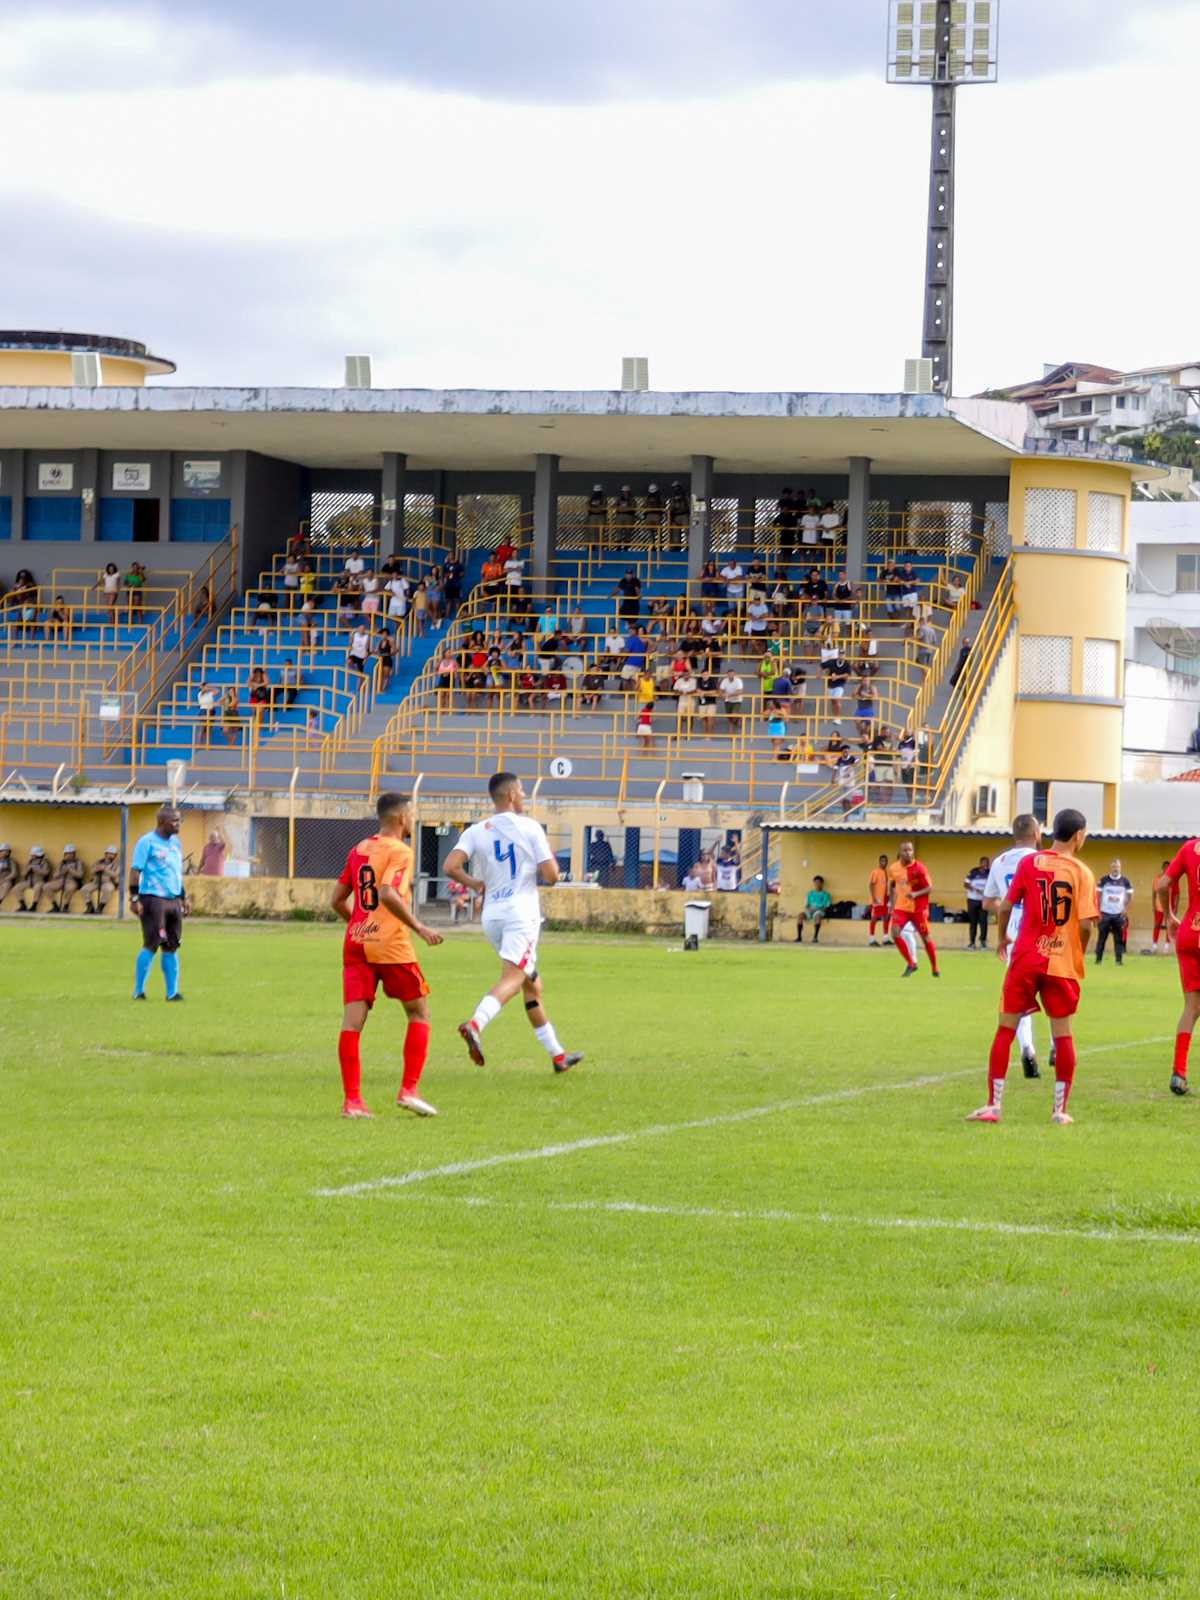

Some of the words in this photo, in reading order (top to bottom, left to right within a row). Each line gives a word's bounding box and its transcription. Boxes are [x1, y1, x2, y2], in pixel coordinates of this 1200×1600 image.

[557, 761, 564, 775] C
[494, 840, 516, 880] 4
[359, 864, 379, 911] 8
[1036, 878, 1073, 926] 16
[1036, 933, 1064, 951] Vida
